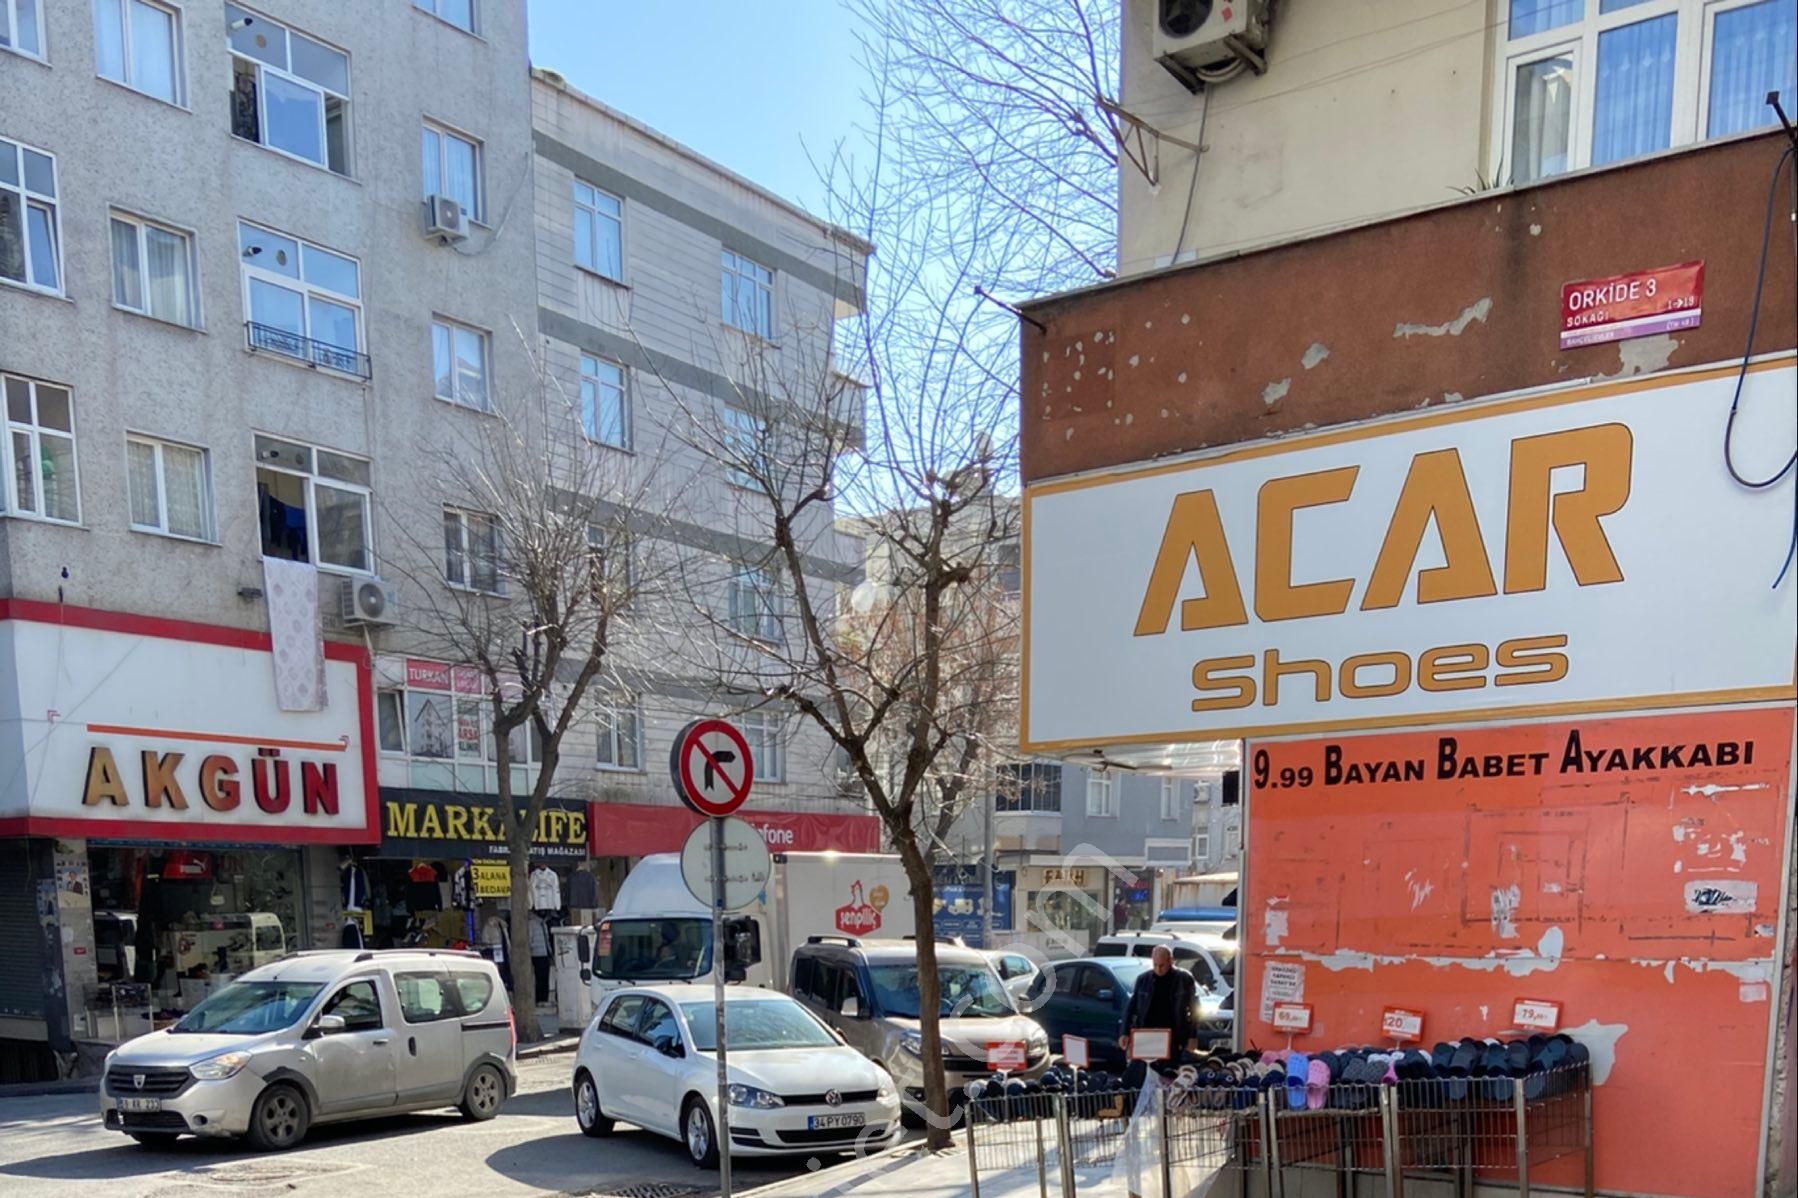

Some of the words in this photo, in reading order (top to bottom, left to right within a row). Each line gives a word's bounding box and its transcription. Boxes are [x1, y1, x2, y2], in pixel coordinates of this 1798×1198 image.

[1569, 282, 1641, 310] ORKİDE
[1645, 278, 1657, 297] 3
[1134, 422, 1633, 636] ACAR
[1191, 634, 1569, 711] shoes
[82, 747, 339, 815] AKGÜN
[1253, 749, 1314, 789] 9.99
[472, 867, 480, 880] 3
